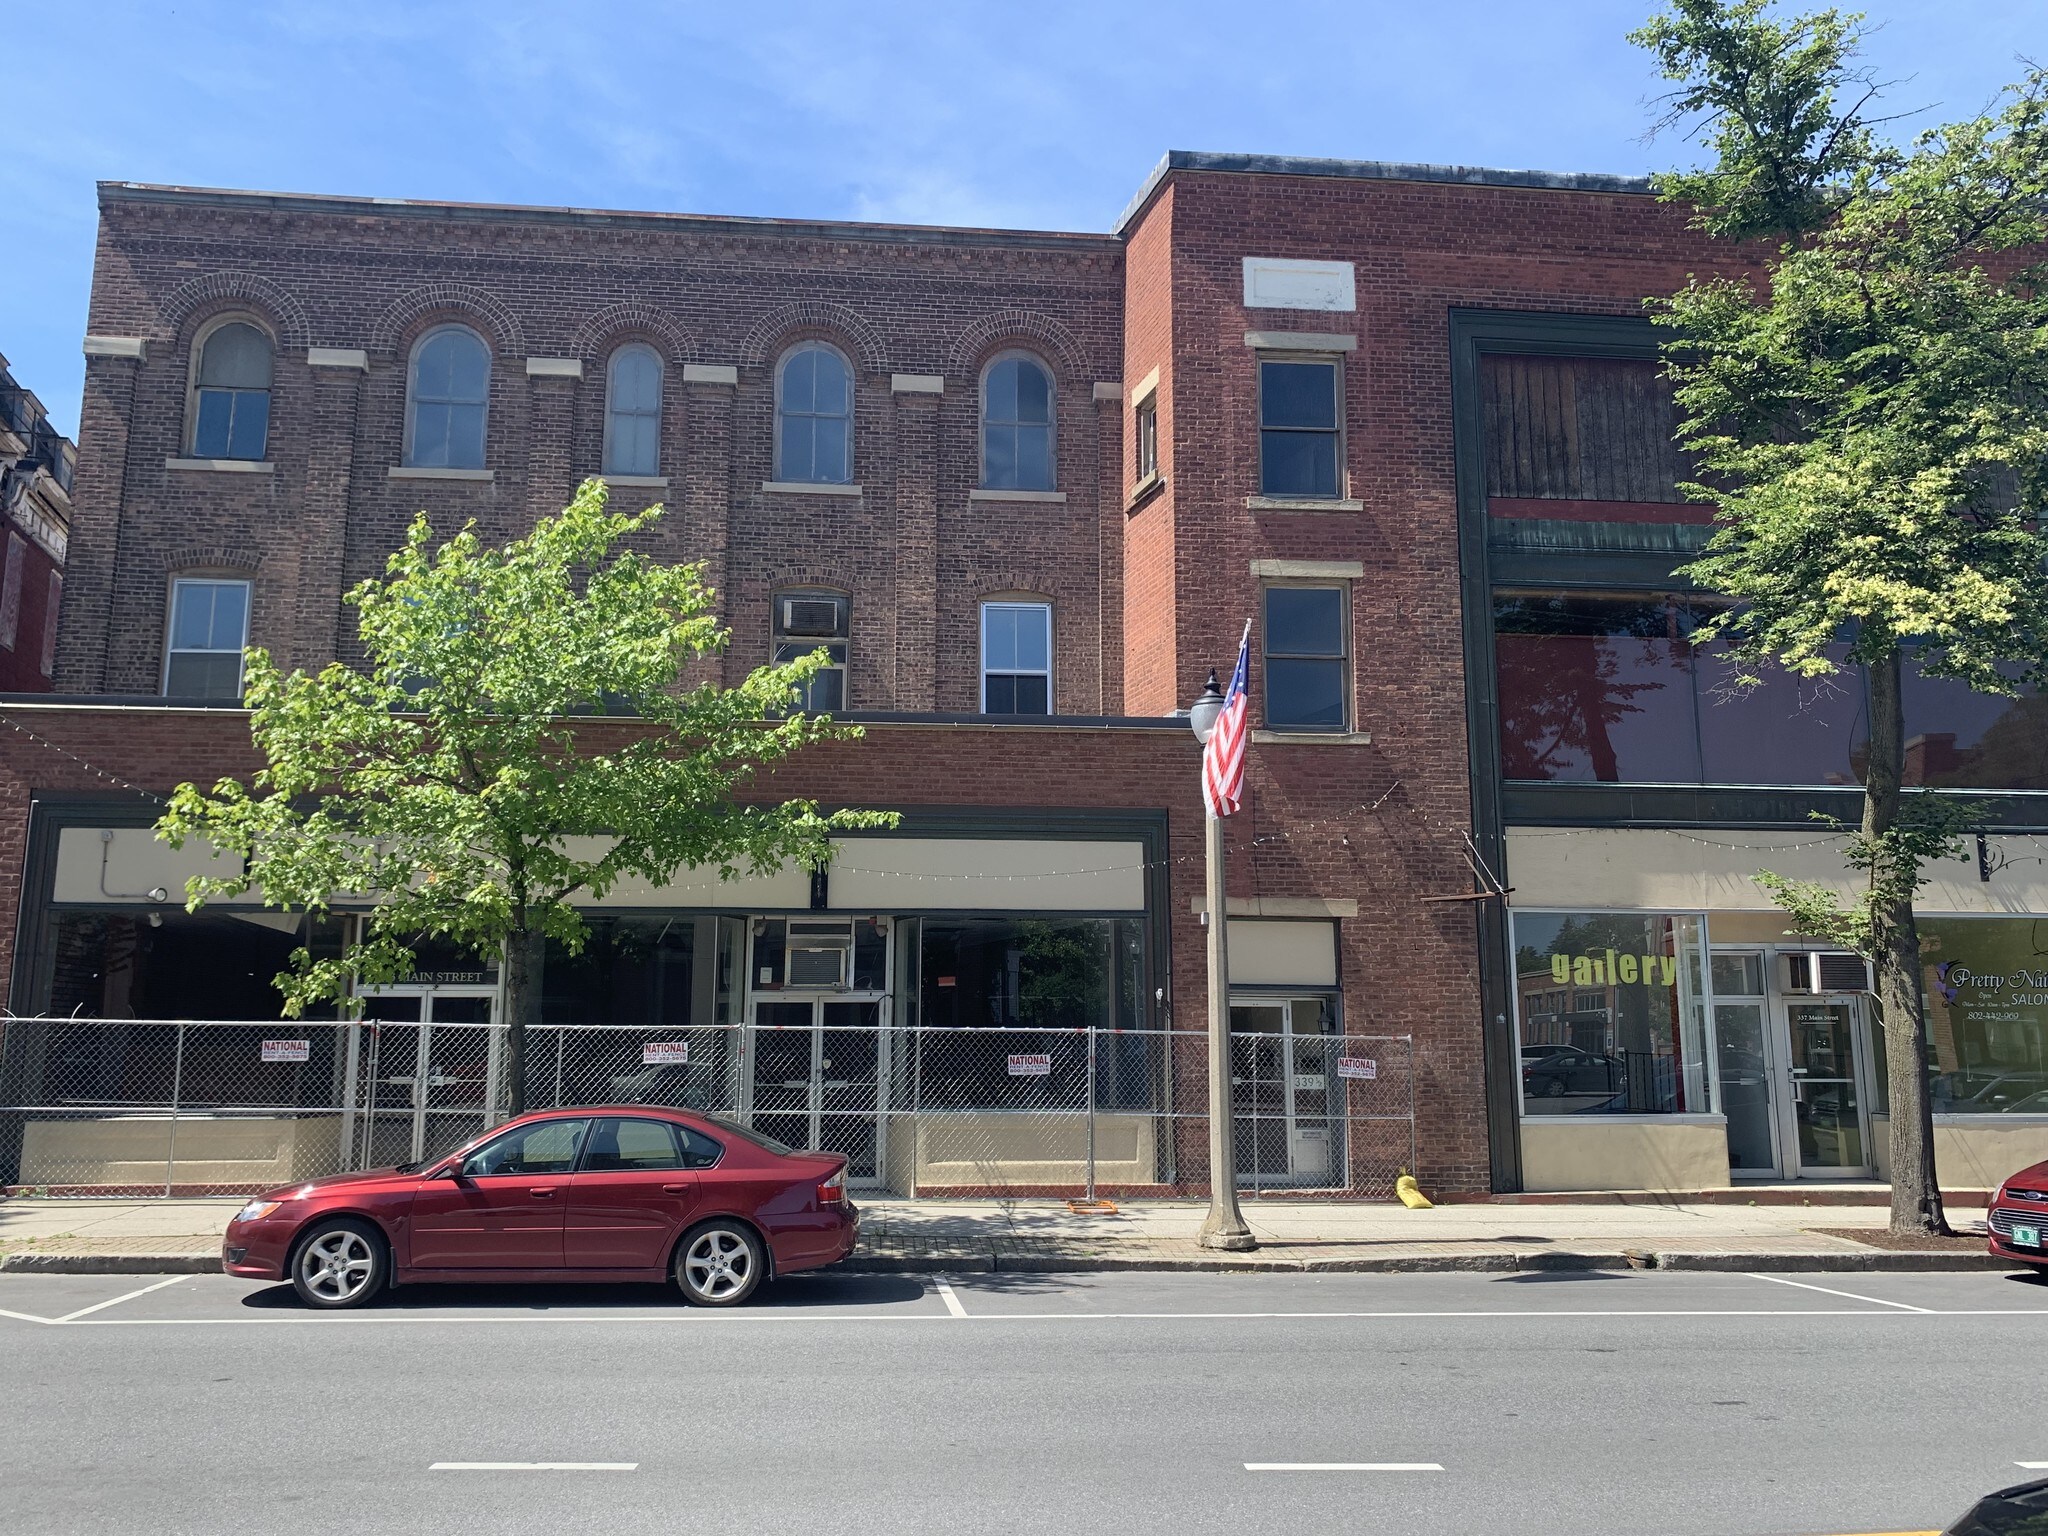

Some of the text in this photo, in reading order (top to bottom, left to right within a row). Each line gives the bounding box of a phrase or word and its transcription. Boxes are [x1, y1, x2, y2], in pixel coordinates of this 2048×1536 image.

[1551, 949, 1676, 986] gallery
[436, 972, 483, 982] STREET
[1952, 968, 2004, 994] Pretty
[264, 1041, 307, 1051] NATIONAL
[645, 1044, 687, 1054] NATIONAL
[1010, 1056, 1049, 1066] NATIONAL
[1339, 1058, 1374, 1070] NATIONAL
